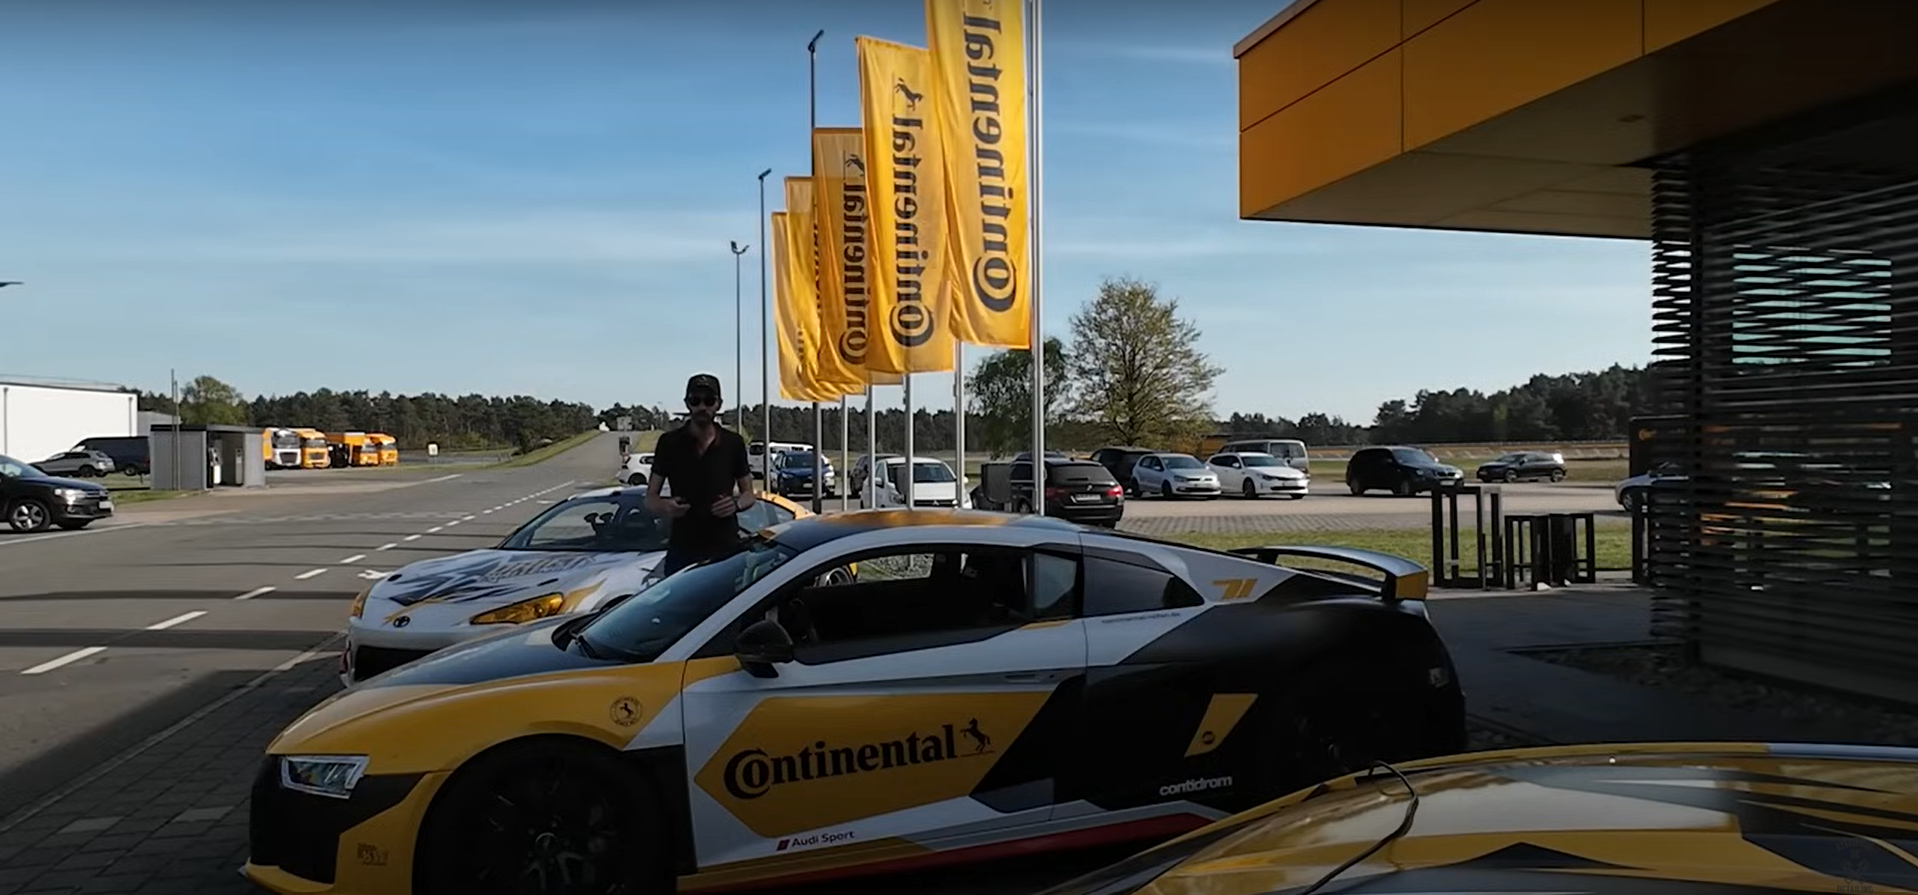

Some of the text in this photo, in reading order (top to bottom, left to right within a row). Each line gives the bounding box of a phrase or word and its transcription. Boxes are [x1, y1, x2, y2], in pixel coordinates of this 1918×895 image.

[723, 724, 958, 800] Continental
[1158, 775, 1234, 797] contidrom
[792, 831, 855, 847] Audi Sport
